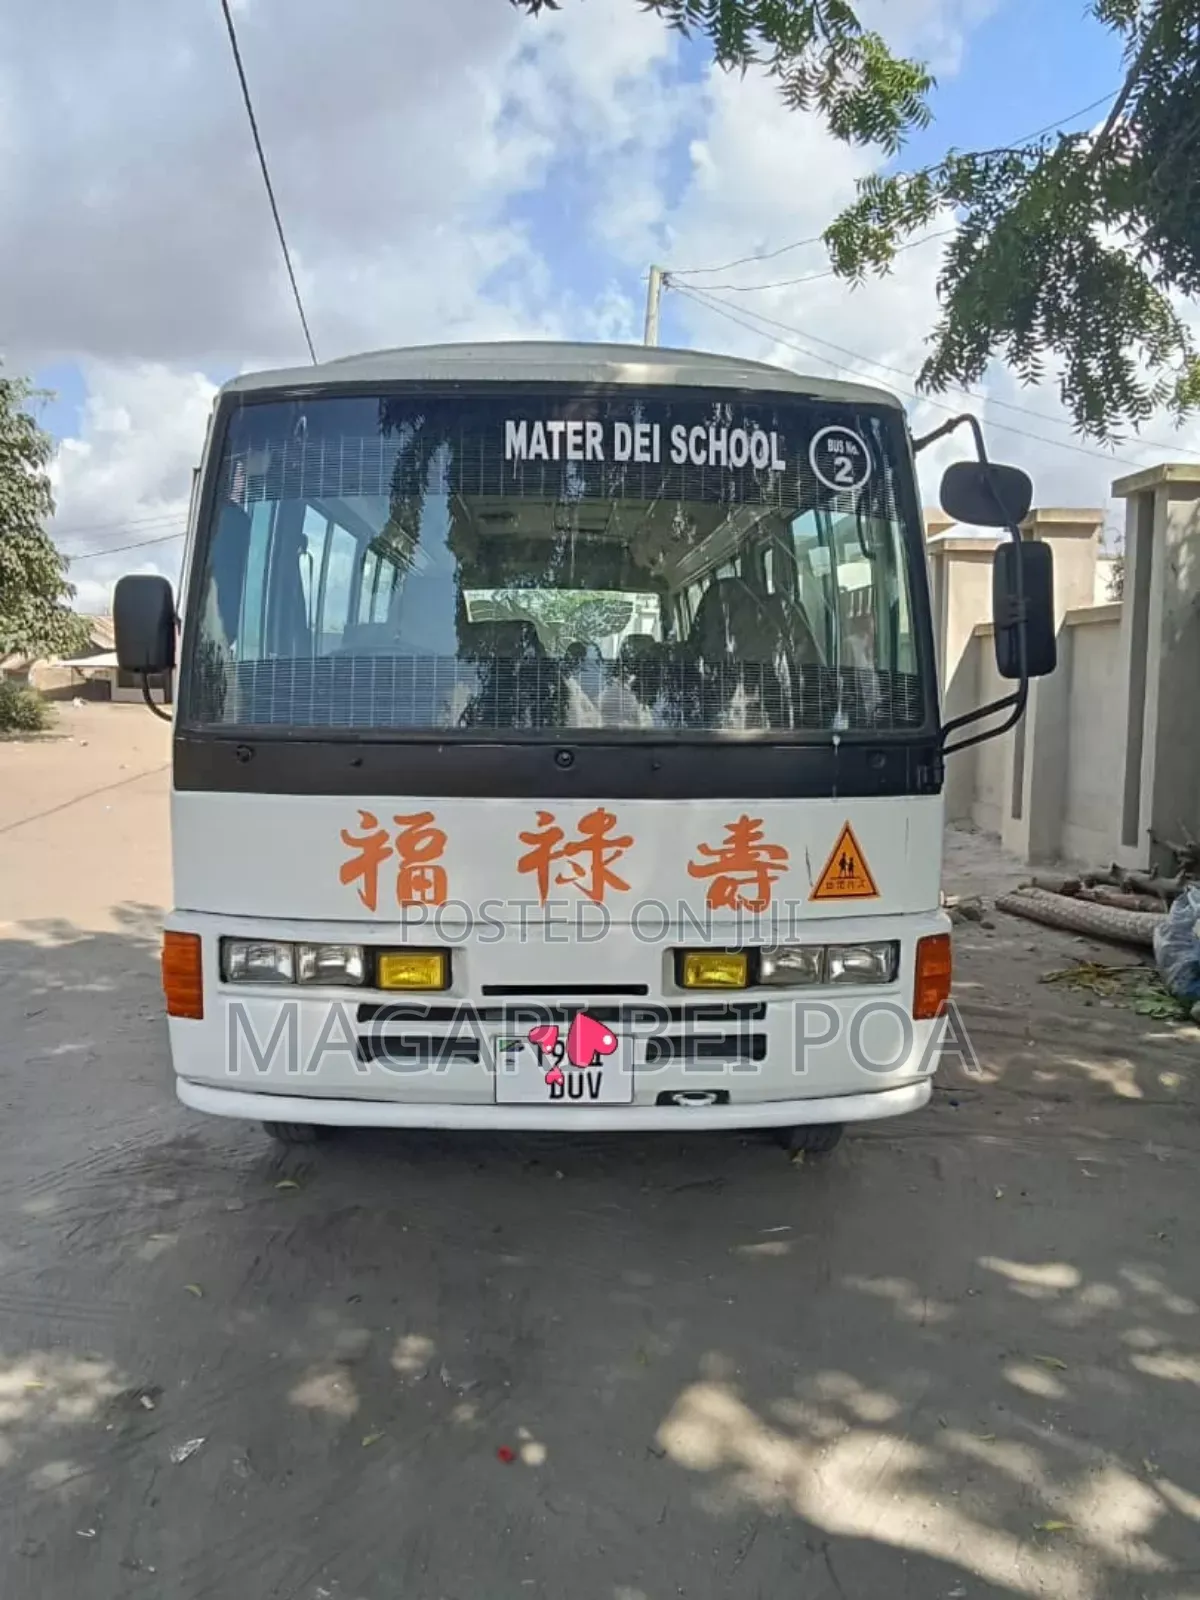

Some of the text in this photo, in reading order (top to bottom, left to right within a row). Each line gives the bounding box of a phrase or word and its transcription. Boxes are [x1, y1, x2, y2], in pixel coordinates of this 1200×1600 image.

[505, 420, 786, 471] MATER DEI SCHOOL
[827, 438, 844, 454] BUS
[834, 456, 854, 483] 2
